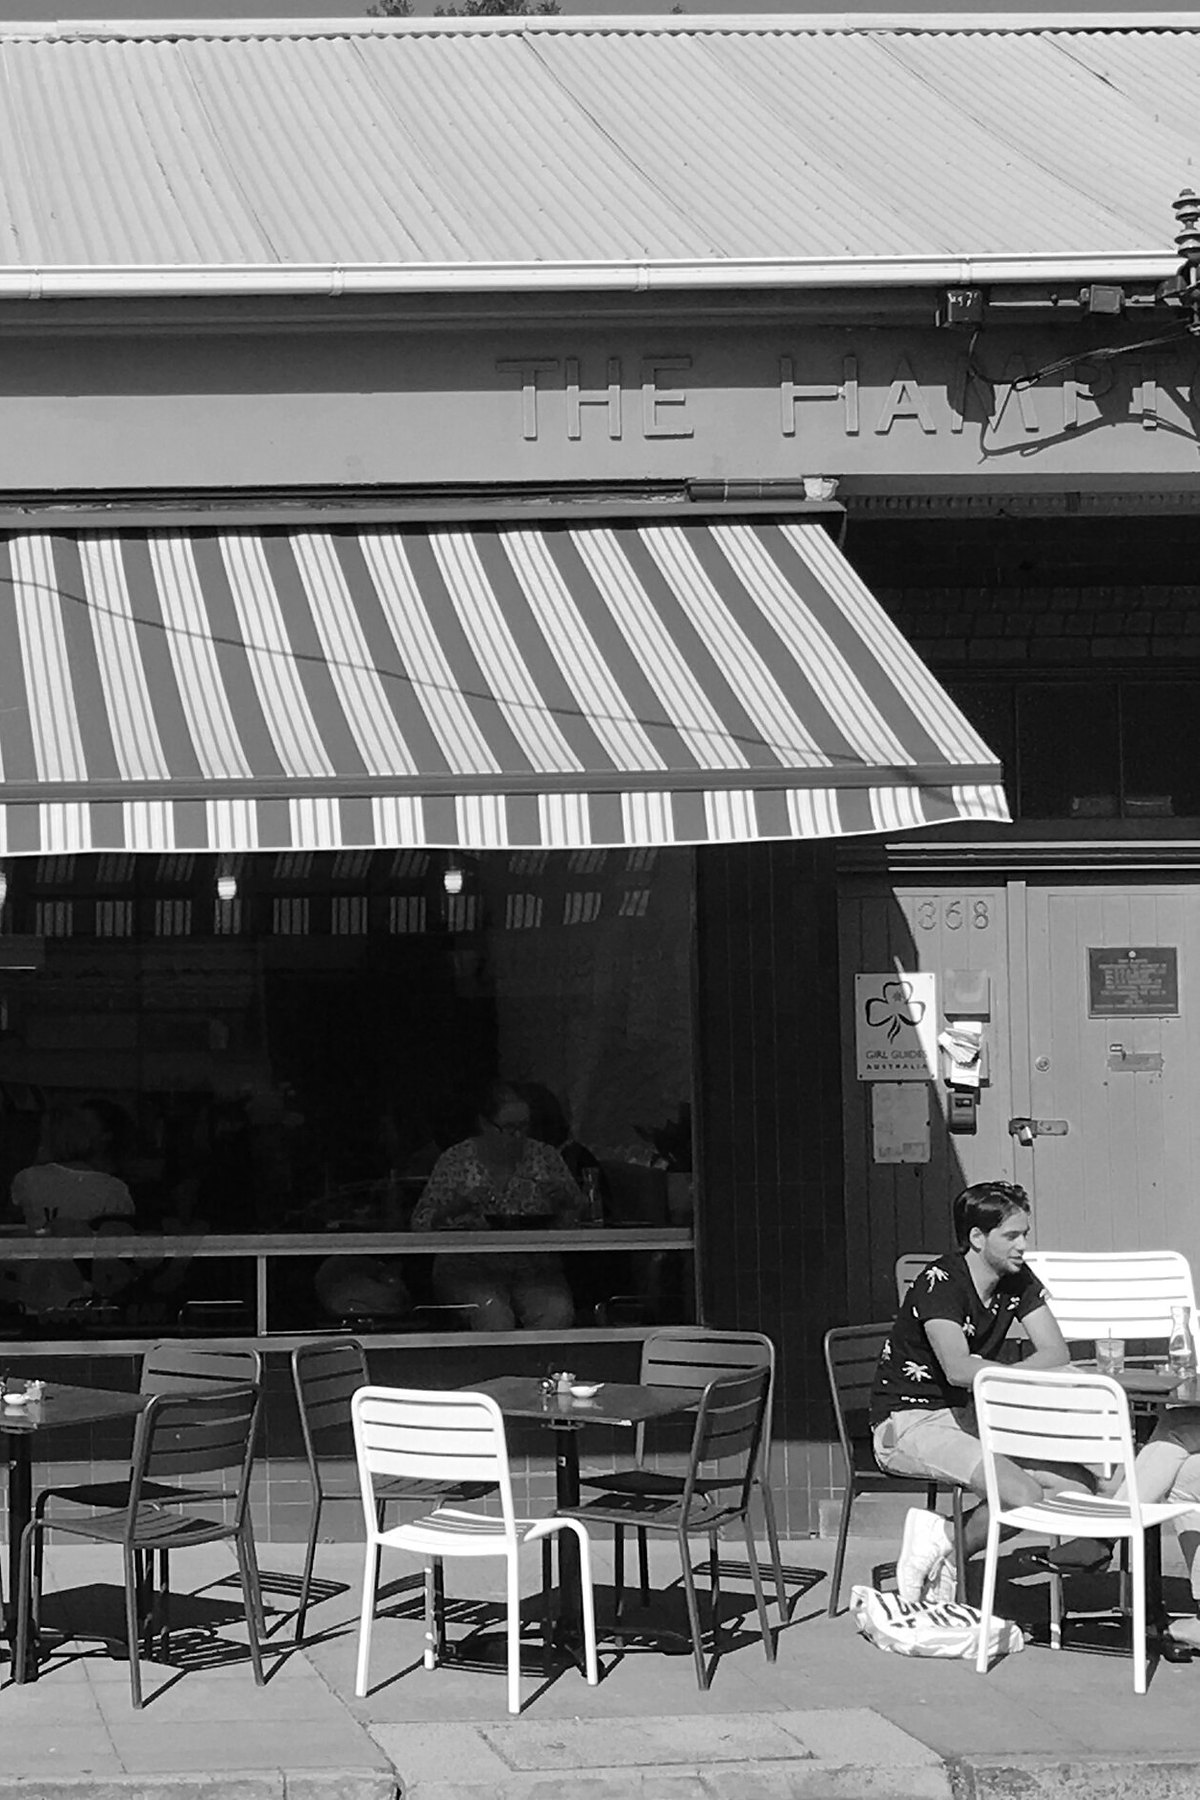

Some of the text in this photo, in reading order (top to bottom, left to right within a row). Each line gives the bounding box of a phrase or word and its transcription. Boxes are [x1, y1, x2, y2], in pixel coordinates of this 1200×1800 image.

[495, 351, 1200, 440] THE HAMPT
[917, 900, 989, 930] 368
[865, 1050, 888, 1059] GIRL
